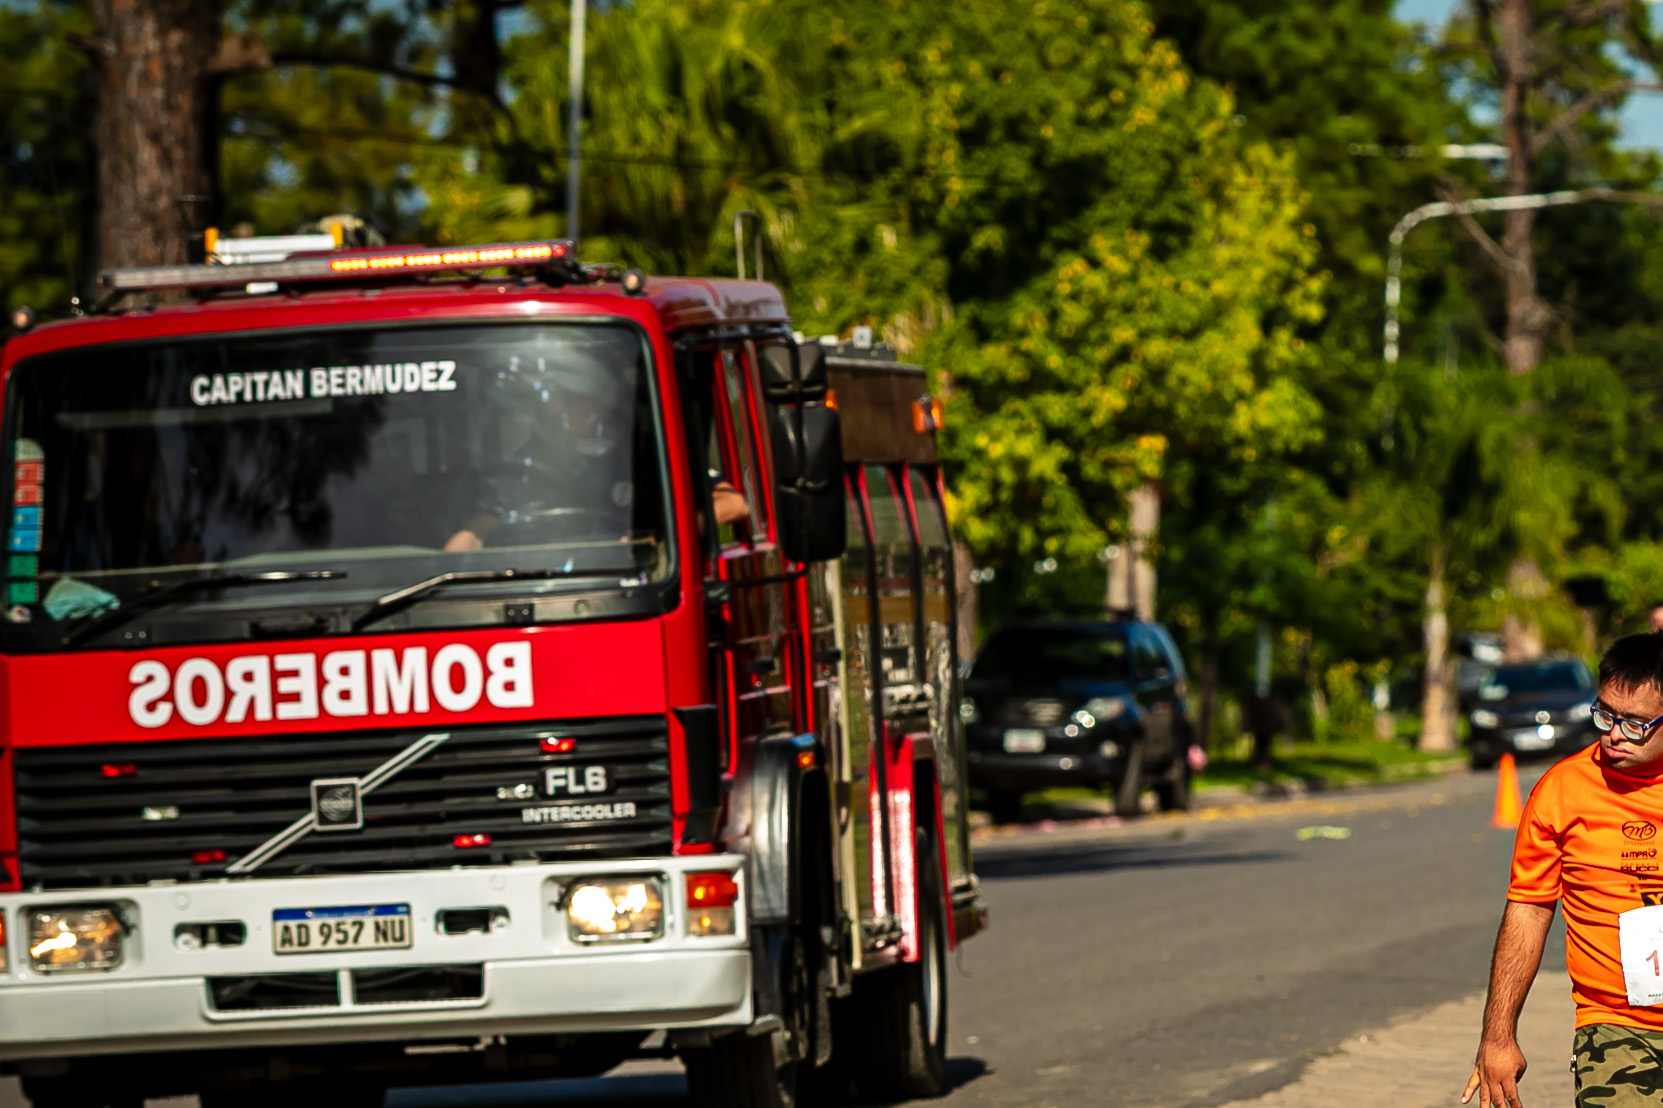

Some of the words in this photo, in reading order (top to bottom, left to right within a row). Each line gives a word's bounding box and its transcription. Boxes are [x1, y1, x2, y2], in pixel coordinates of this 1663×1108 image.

[190, 369, 304, 405] CAPITAN
[310, 360, 457, 397] BERMUDEZ
[545, 765, 608, 796] FL6
[521, 802, 637, 823] INTERCOOLER
[280, 923, 311, 948] AD
[318, 919, 365, 946] 957
[374, 918, 405, 943] NU
